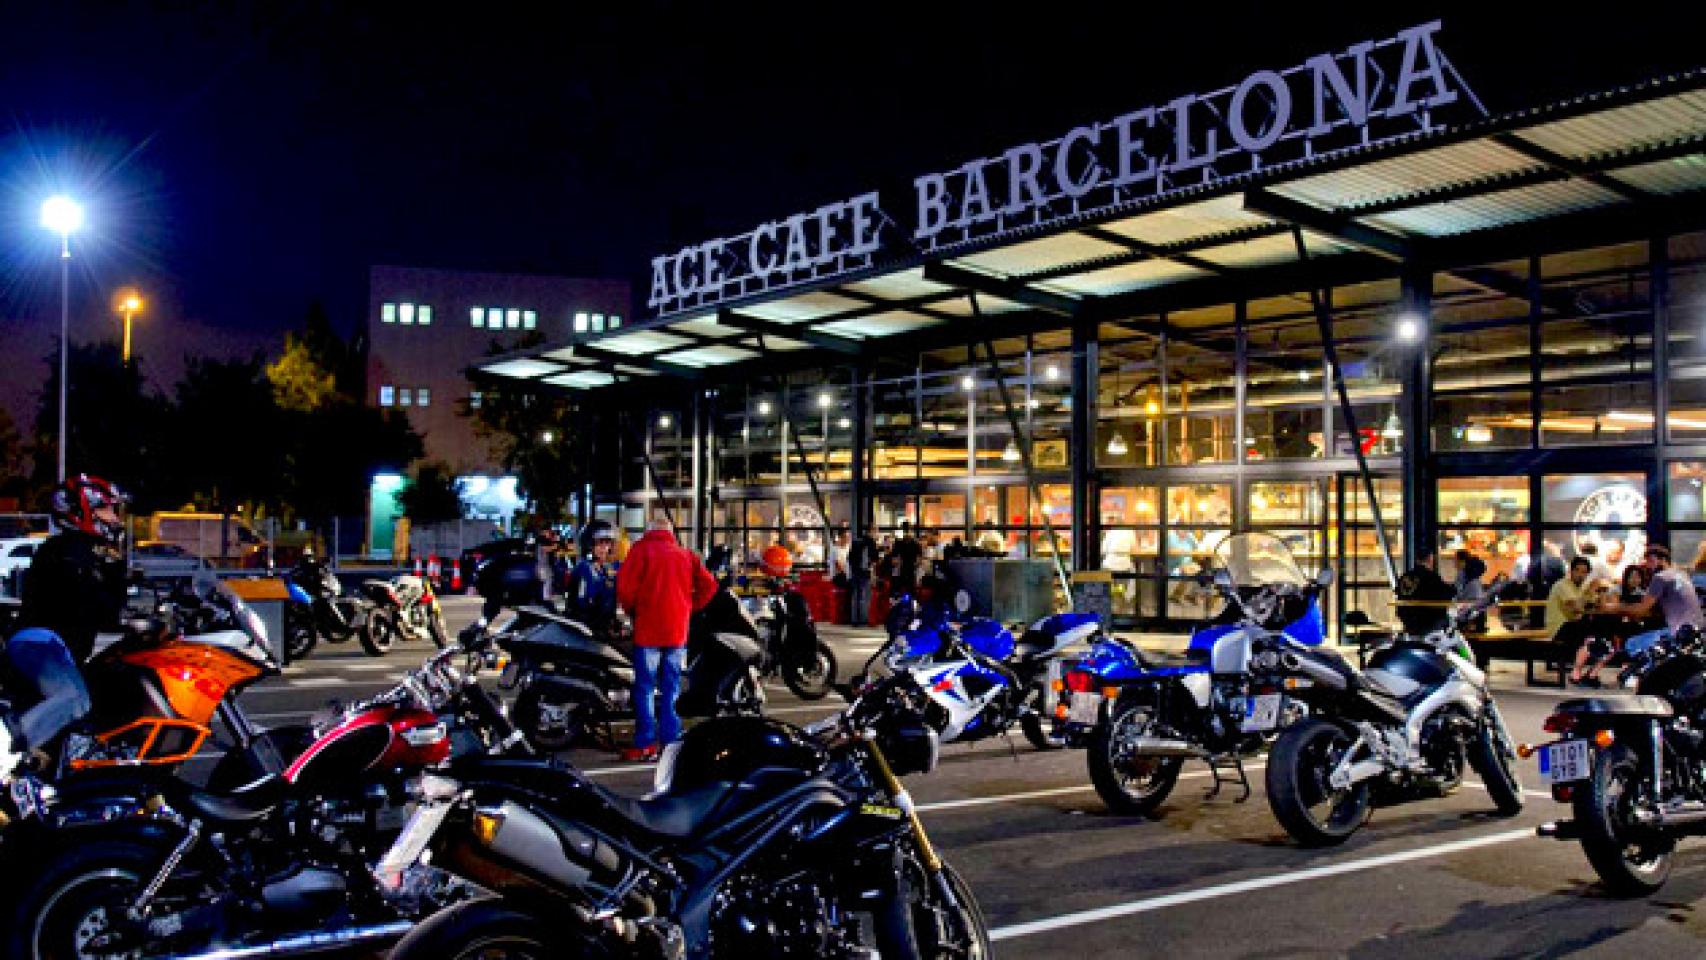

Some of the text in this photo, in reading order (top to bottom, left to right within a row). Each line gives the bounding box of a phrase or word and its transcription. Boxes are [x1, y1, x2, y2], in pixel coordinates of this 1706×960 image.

[648, 19, 1458, 308] ACE CAFE BARCELONA
